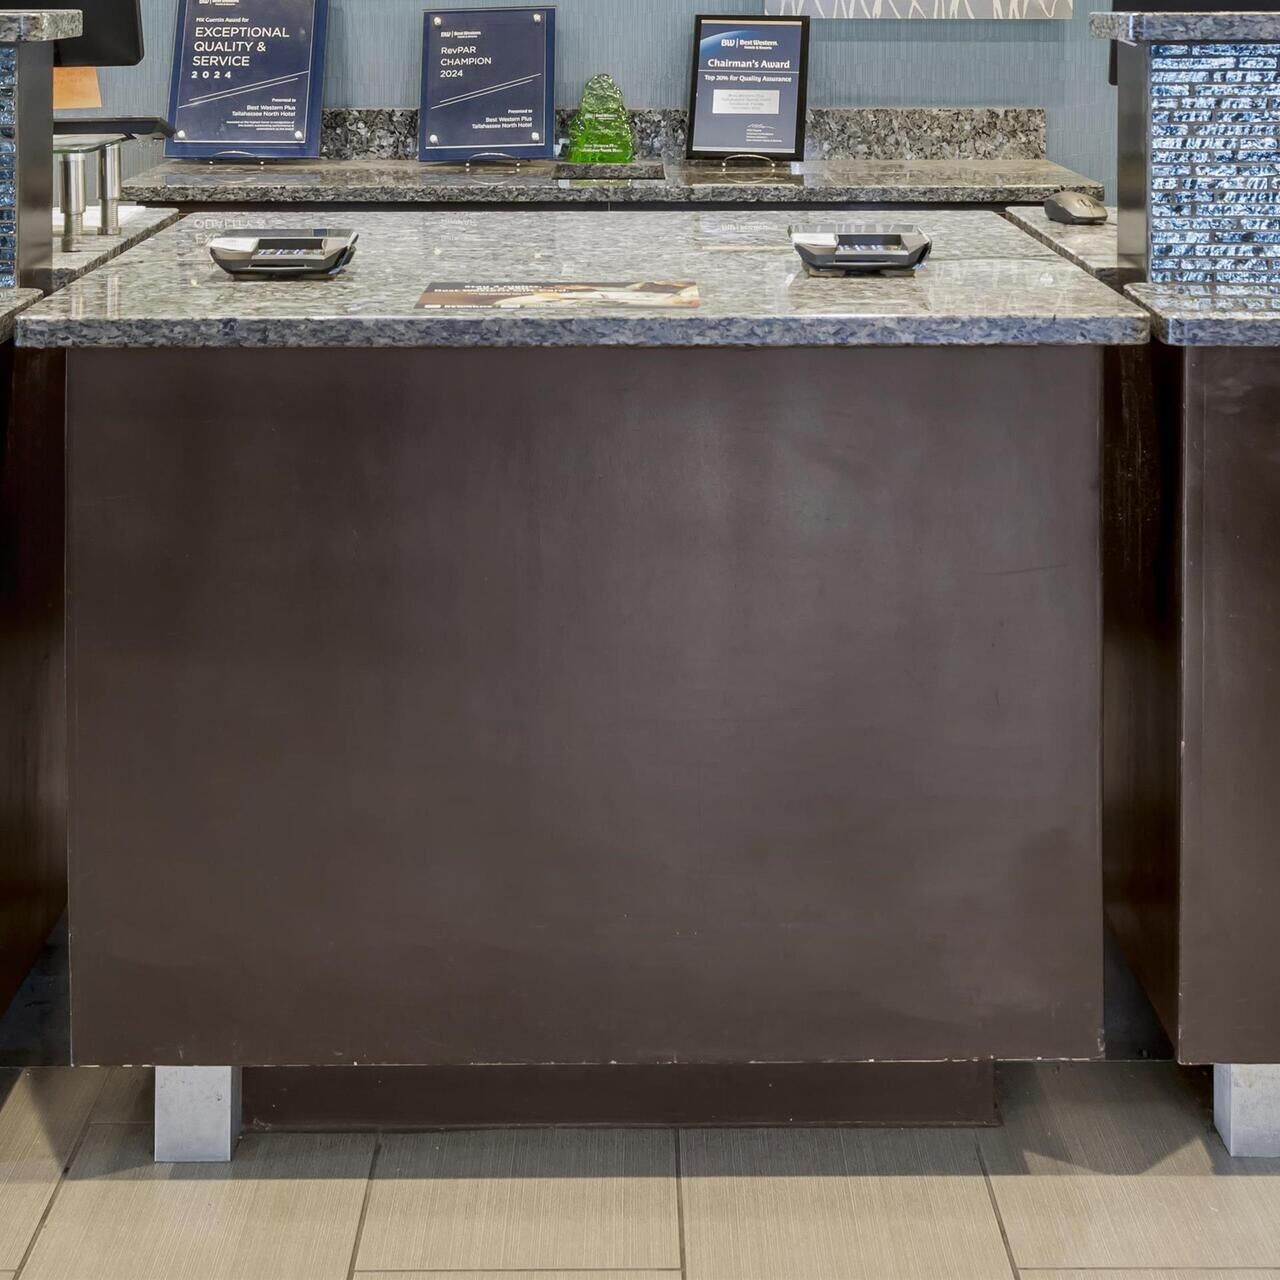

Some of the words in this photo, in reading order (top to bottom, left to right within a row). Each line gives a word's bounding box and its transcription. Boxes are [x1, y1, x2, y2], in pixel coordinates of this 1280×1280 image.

[195, 26, 290, 37] EXCEPTIONAL
[194, 41, 254, 52] QUALITY
[256, 41, 266, 52] &
[721, 38, 735, 47] BW
[441, 46, 477, 55] RevPAR
[192, 55, 250, 66] SERVICE
[440, 57, 492, 66] CHAMPION
[708, 58, 759, 68] Chairman's
[761, 60, 790, 68] Award
[440, 70, 463, 78] 2024
